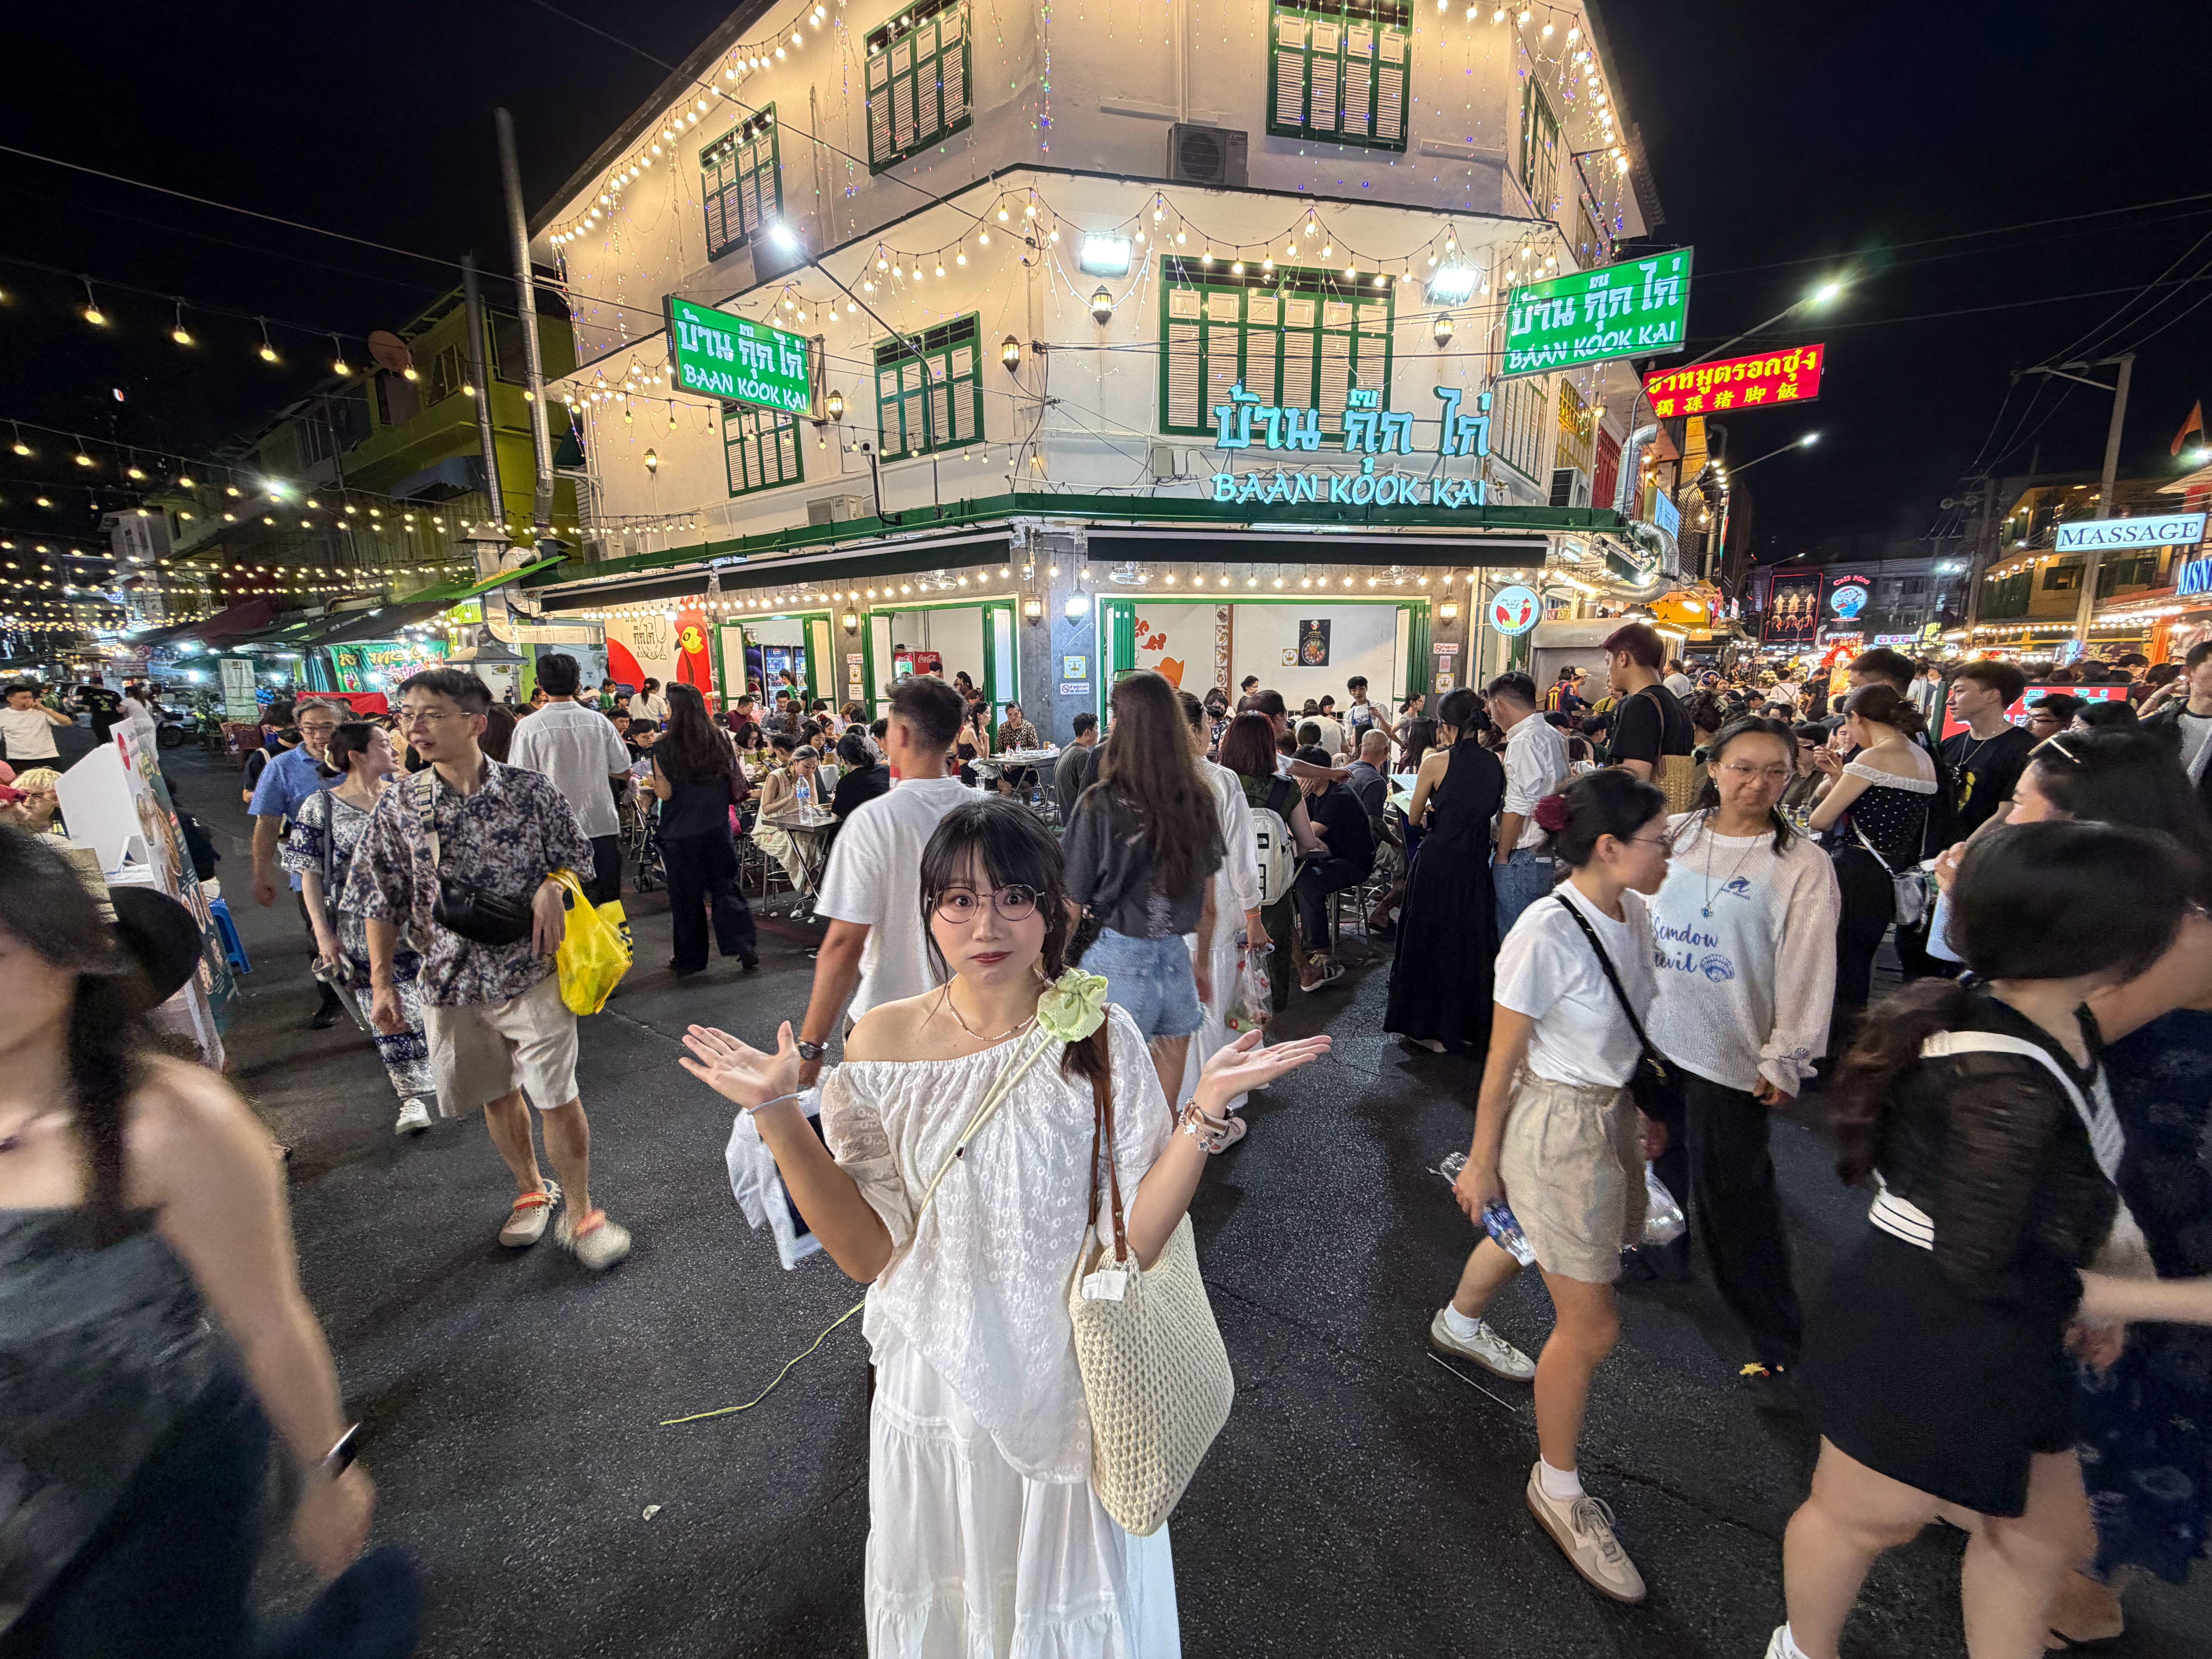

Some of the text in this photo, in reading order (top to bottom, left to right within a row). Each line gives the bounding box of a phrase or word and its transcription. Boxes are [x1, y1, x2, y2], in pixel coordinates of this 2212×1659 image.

[1511, 257, 1681, 336] บ้าน กุ๊ก ไก่
[678, 308, 805, 380] บ้าน กุ๊ก ไก่
[1508, 320, 1676, 369] BAAN KOOK KAI
[683, 363, 806, 410] BAAN KOOK KAI
[1214, 384, 1492, 474] บ้าน กุ๊ก ไก่
[1211, 473, 1486, 509] BAAN KOOK KAI
[2058, 521, 2198, 546] MASSAGE
[1511, 625, 1527, 634] Food
